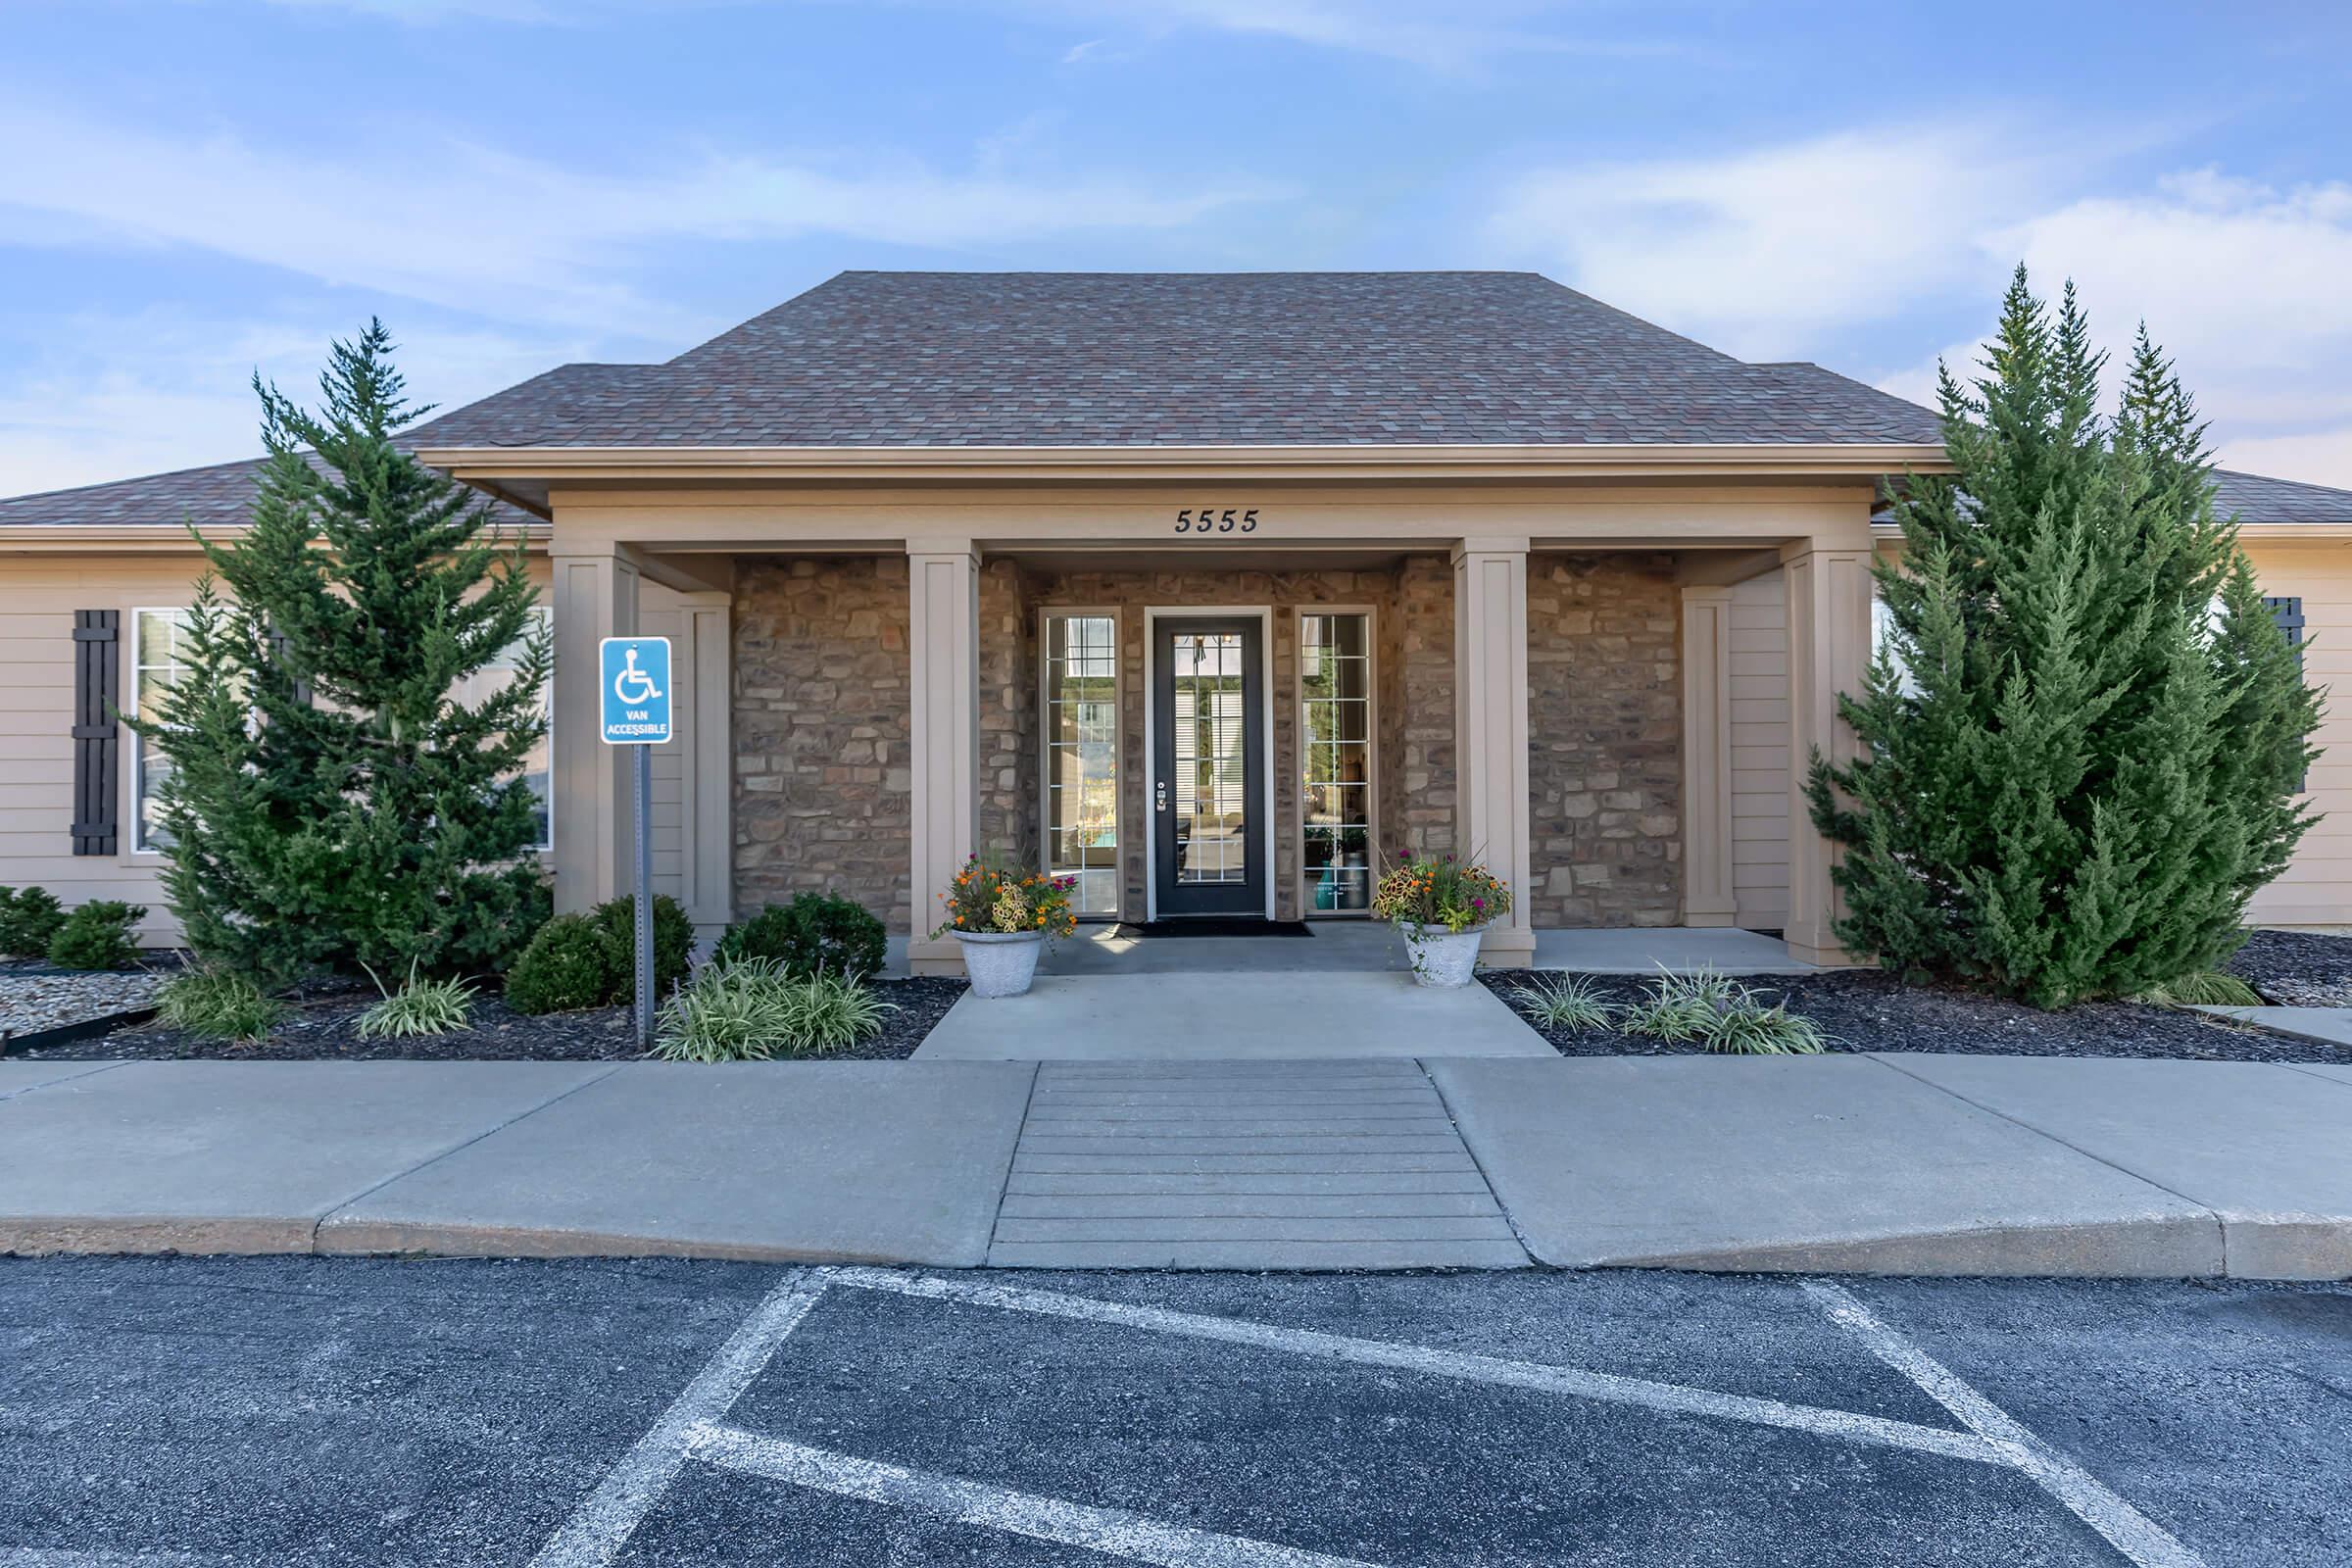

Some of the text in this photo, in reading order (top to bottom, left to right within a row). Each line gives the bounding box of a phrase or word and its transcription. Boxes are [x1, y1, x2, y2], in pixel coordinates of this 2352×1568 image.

[1175, 509, 1259, 532] 5555
[625, 710, 649, 721] VAN
[607, 723, 667, 735] ACCESSIBLE
